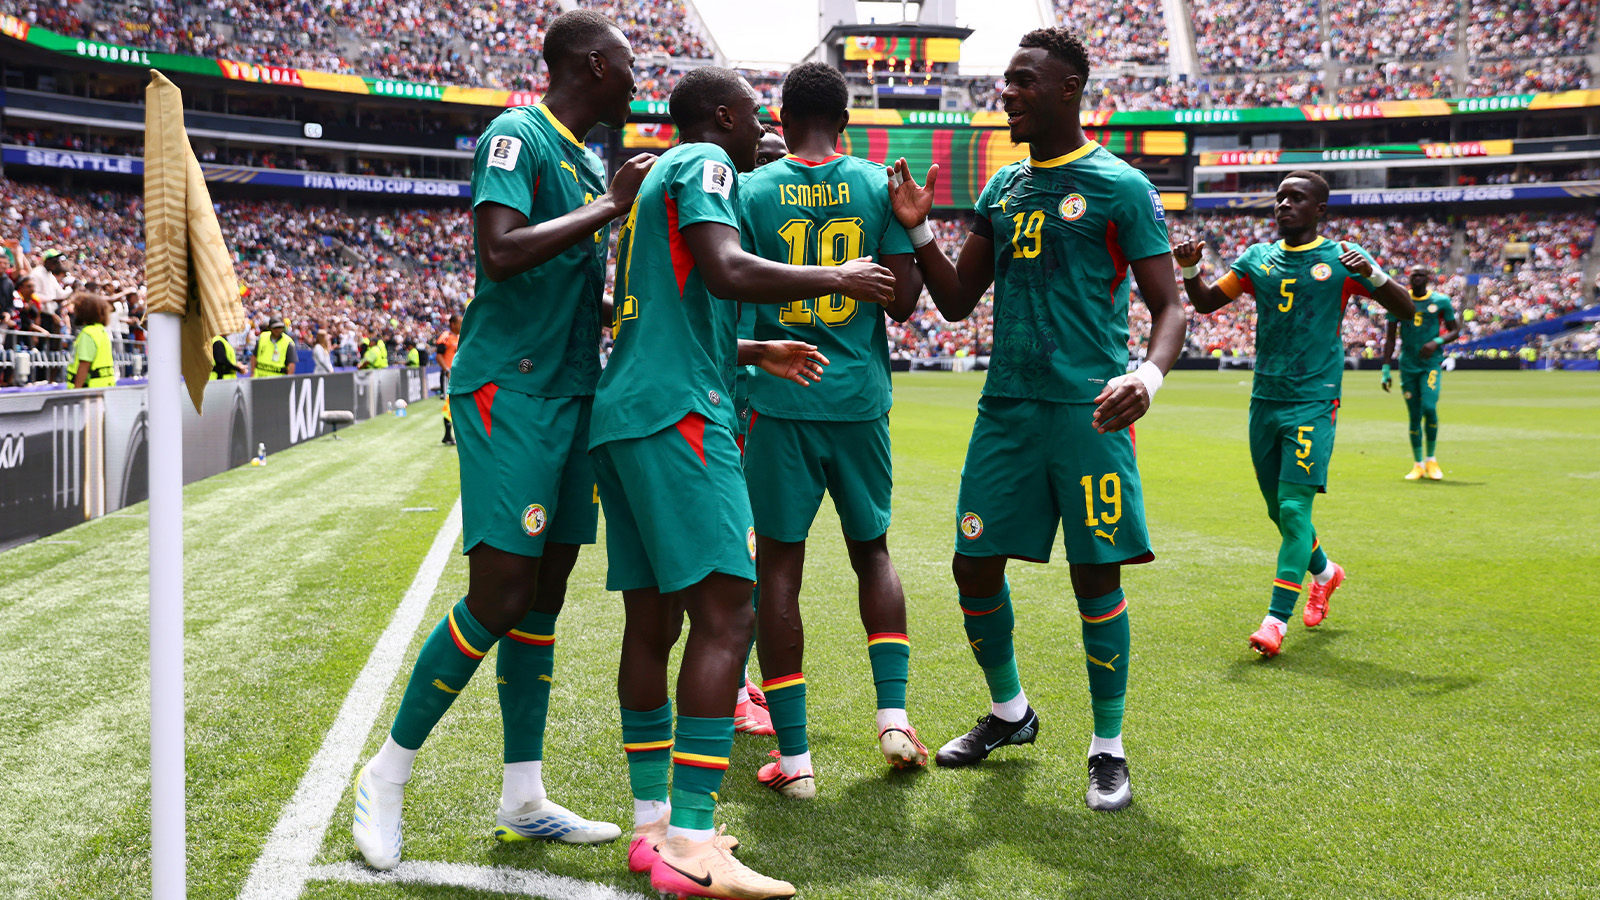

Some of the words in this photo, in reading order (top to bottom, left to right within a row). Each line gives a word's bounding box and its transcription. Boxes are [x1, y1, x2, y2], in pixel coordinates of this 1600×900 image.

[76, 41, 151, 65] GOOOOAL
[26, 150, 132, 173] SEATTLE
[303, 175, 335, 189] FIFA
[335, 177, 383, 192] WORLD
[385, 180, 412, 193] CUP
[413, 182, 460, 197] 2026
[779, 182, 850, 207] ISMAÏLA
[1351, 193, 1383, 205] FIFA
[1383, 191, 1433, 204] WORLD
[1434, 189, 1462, 202] CUP
[1463, 187, 1515, 200] 2026
[1012, 210, 1046, 259] 19
[778, 216, 865, 328] 18
[1277, 278, 1297, 313] 5
[1427, 370, 1438, 385] 6
[289, 376, 325, 444] KIA
[1295, 426, 1314, 459] 5
[1080, 472, 1122, 526] 19
